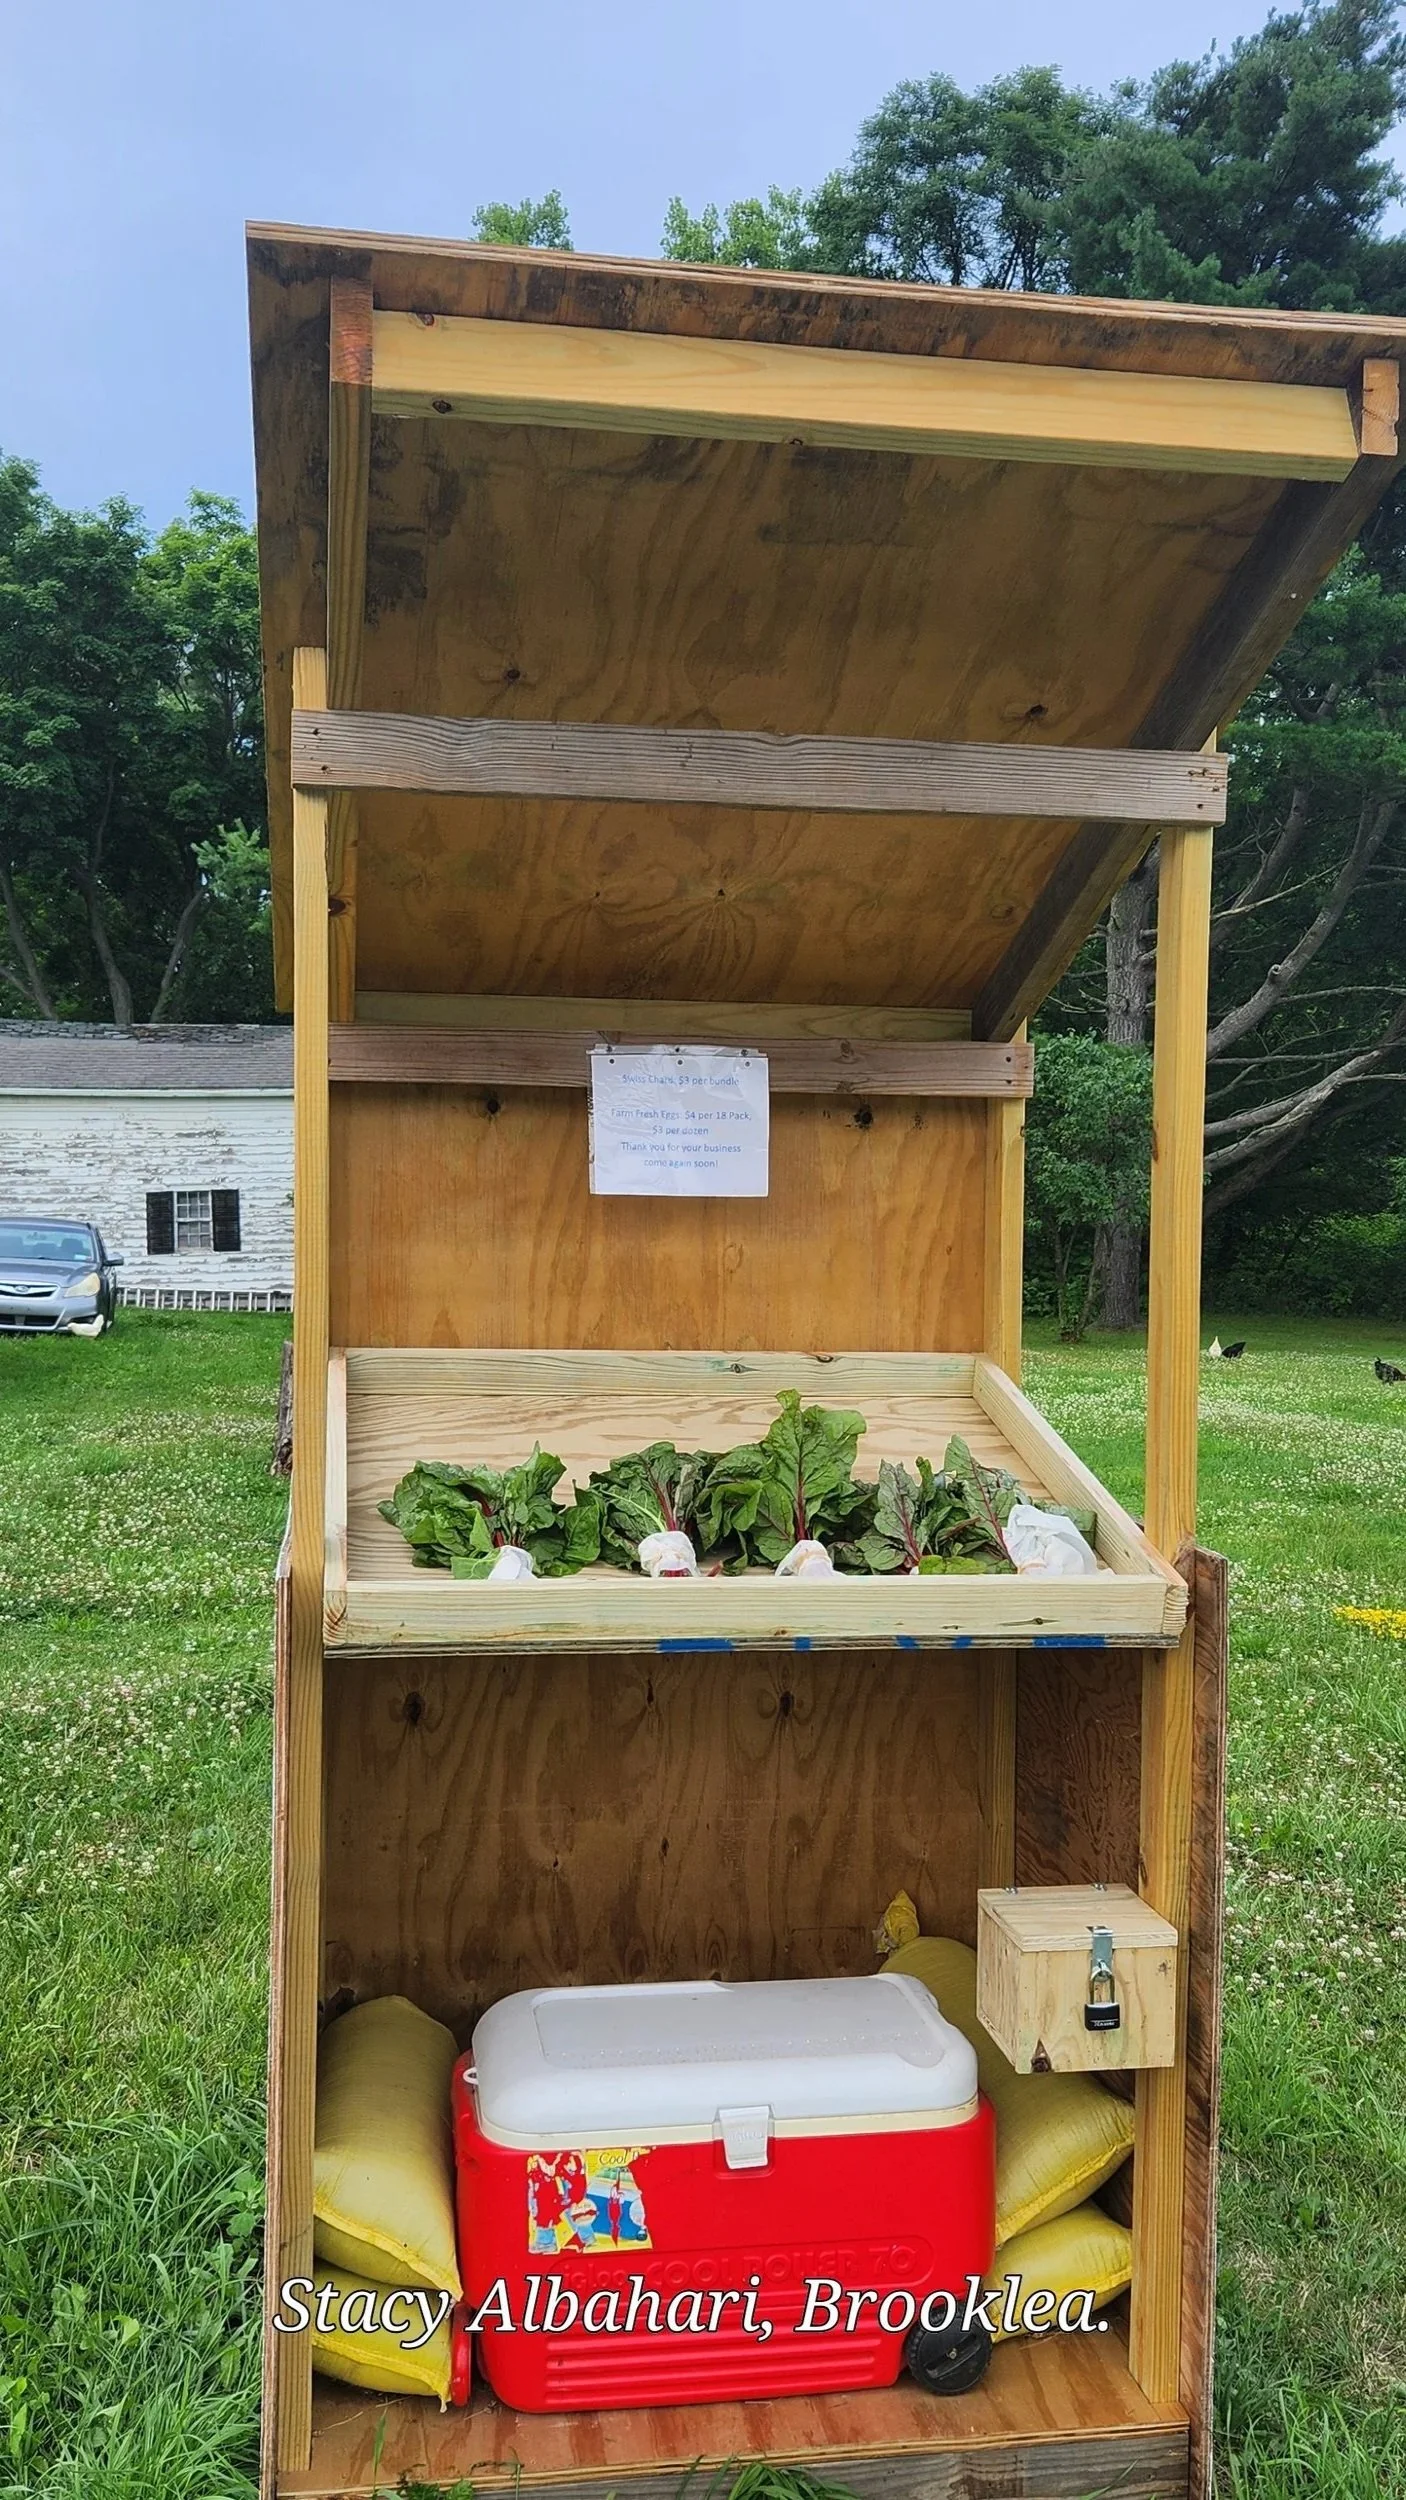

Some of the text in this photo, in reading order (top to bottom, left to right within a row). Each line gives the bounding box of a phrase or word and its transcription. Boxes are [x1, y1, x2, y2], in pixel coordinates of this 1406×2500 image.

[622, 1074, 646, 1084] Swiss
[678, 1075, 690, 1085] $3
[692, 1078, 708, 1086] per
[709, 1076, 740, 1086] bundle
[611, 1108, 634, 1118] Farm
[636, 1109, 659, 1119] Fresh
[684, 1110, 696, 1120] $4
[698, 1112, 714, 1121] per
[716, 1111, 727, 1120] 18
[652, 1124, 709, 1135] $3 per dozen
[620, 1141, 741, 1152] Thank you for your business
[644, 1159, 667, 1167] come
[669, 1159, 692, 1168] again
